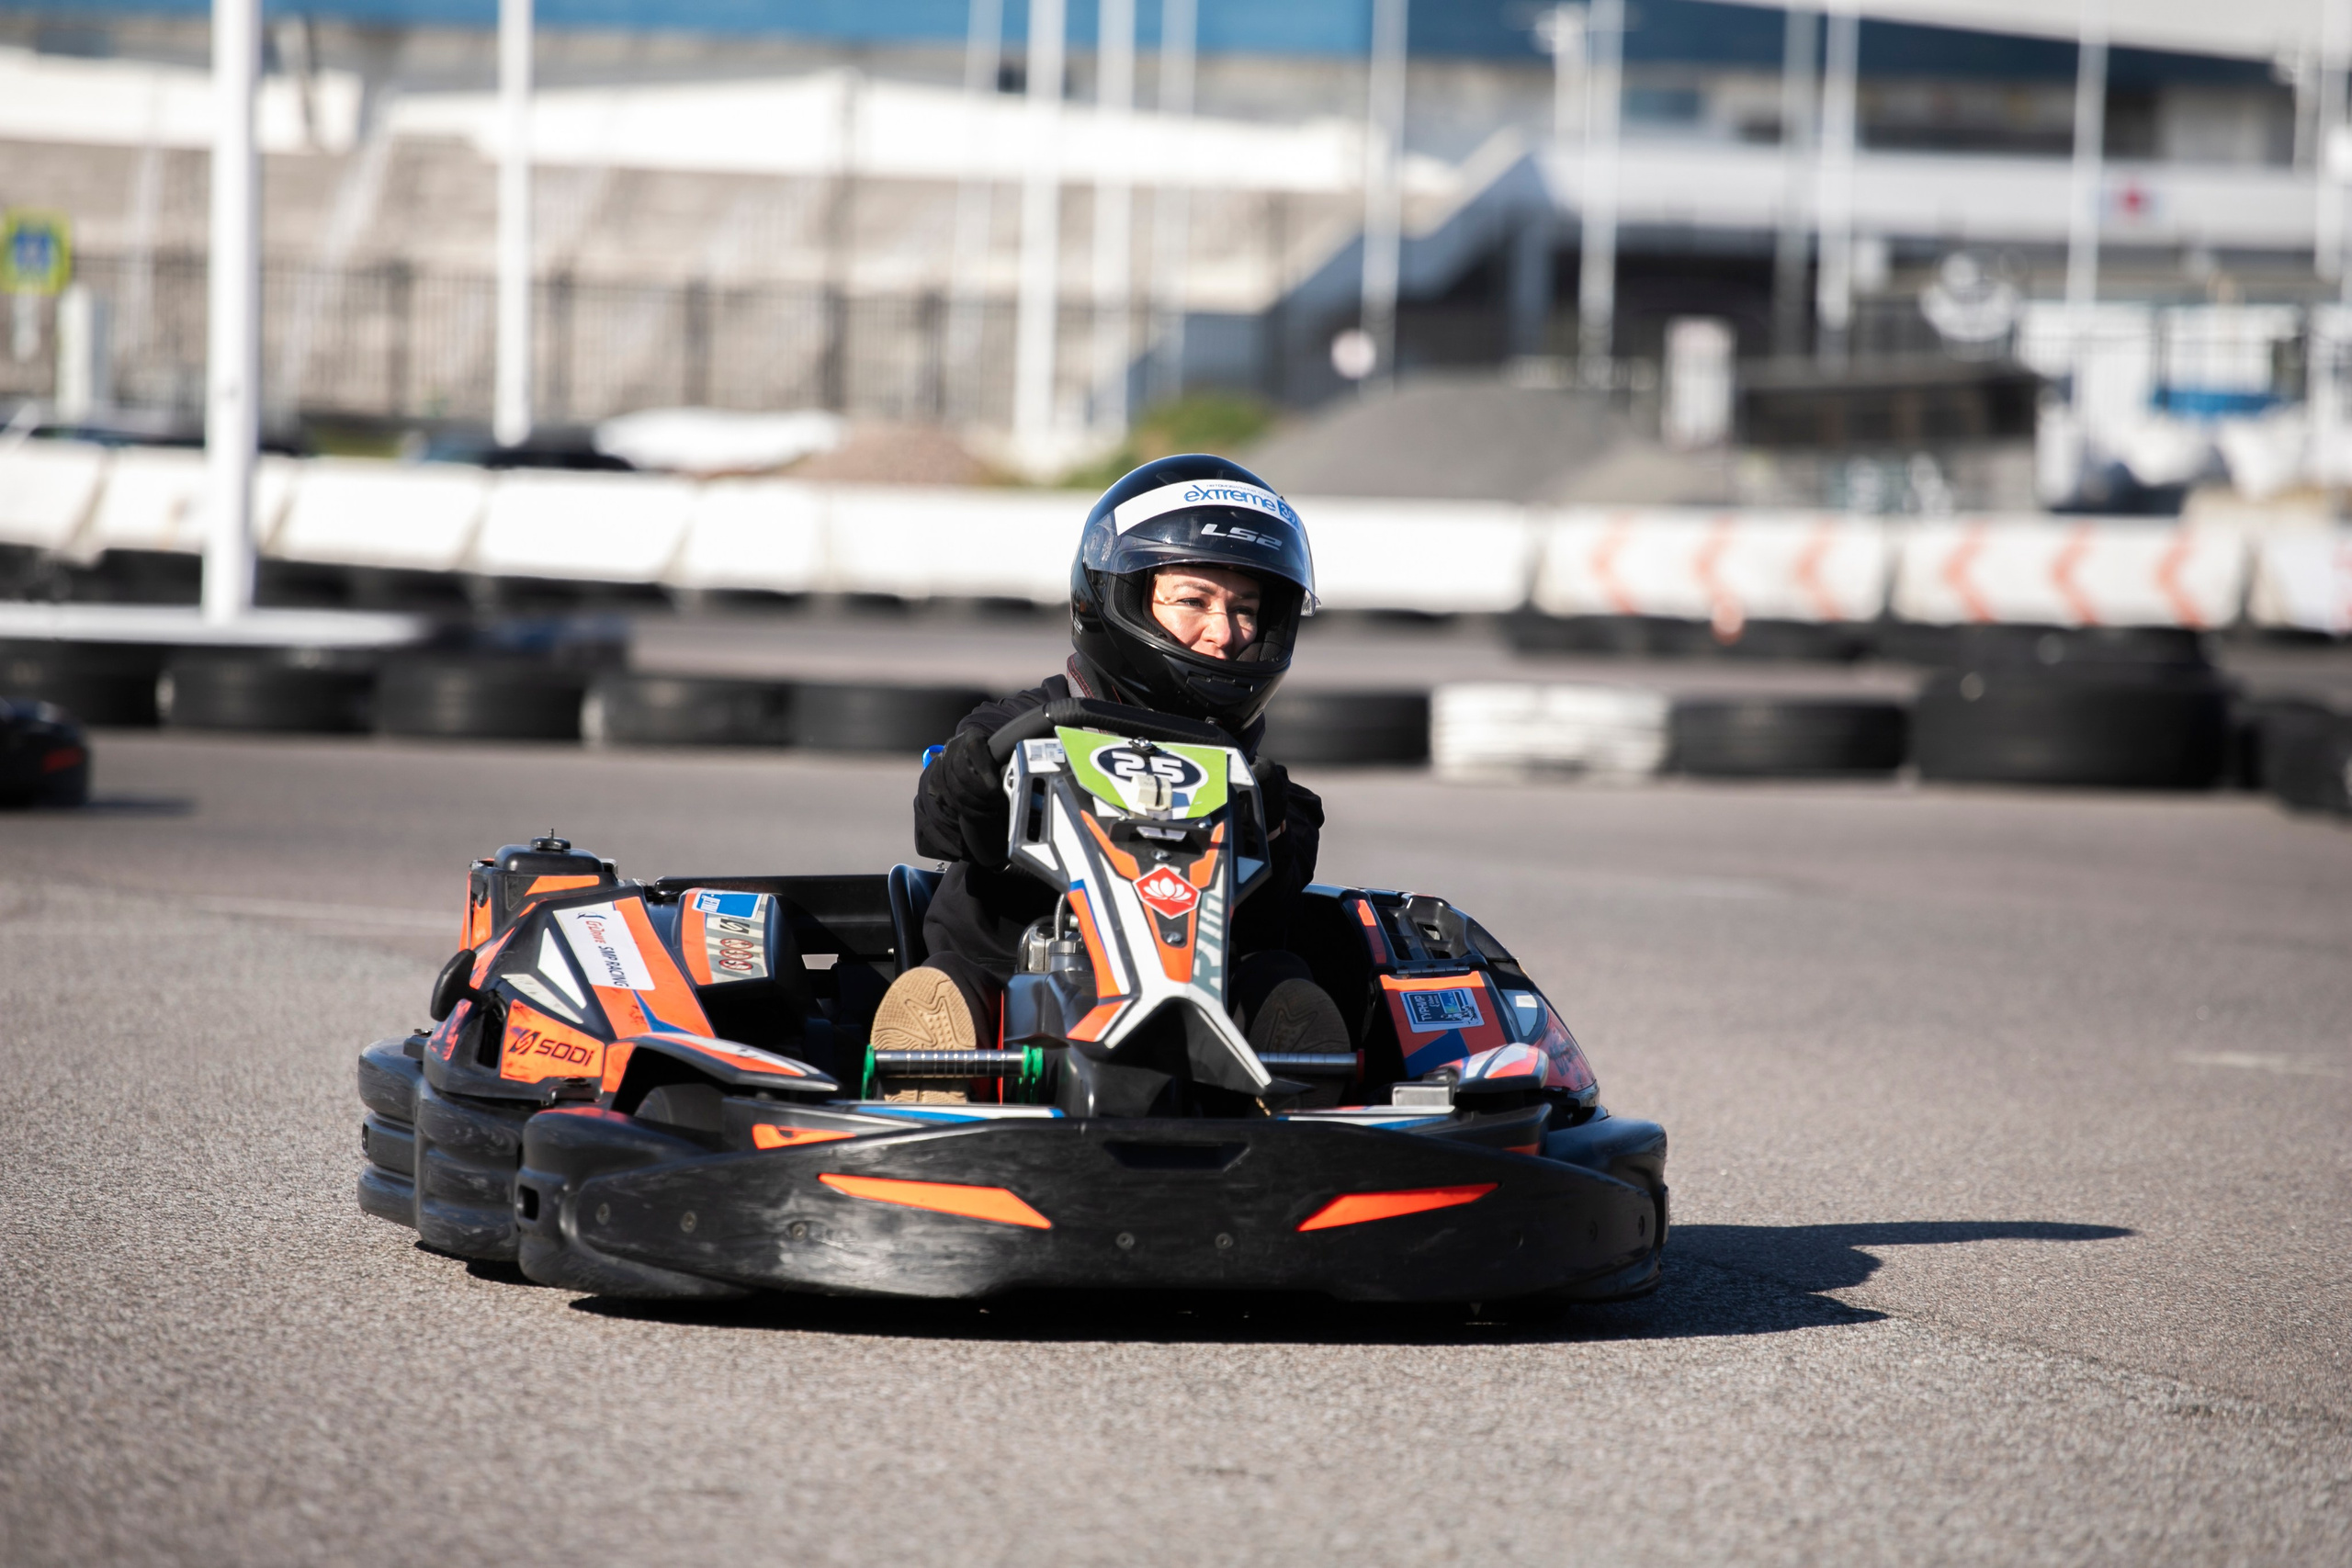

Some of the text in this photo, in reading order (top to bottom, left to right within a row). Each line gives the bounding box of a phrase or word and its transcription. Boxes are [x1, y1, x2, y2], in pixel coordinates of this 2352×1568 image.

[1280, 502, 1296, 525] 39
[1201, 523, 1283, 551] LS2
[1112, 751, 1185, 784] 25
[598, 945, 618, 961] SMP
[605, 960, 629, 987] RACING
